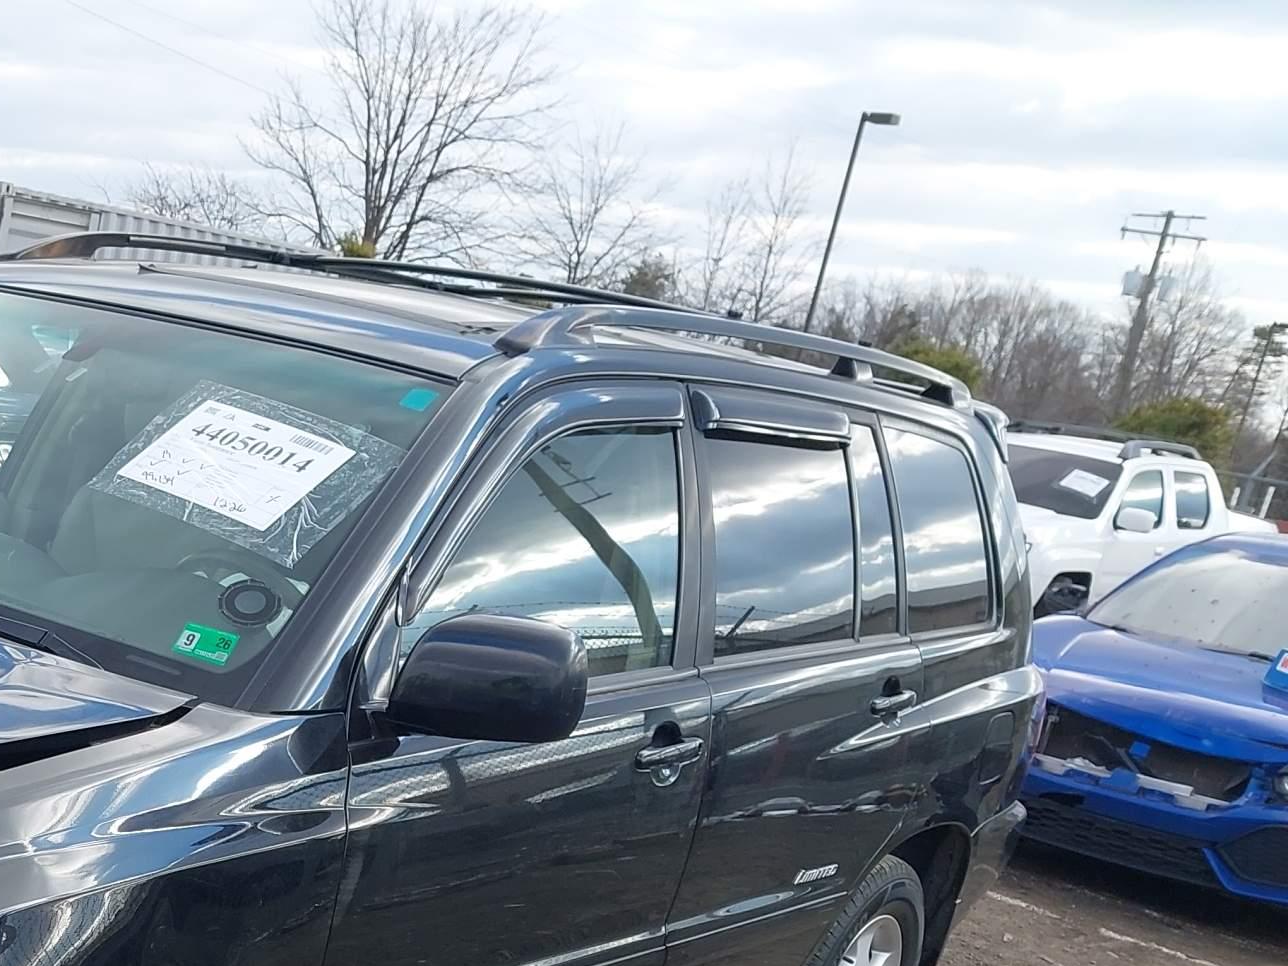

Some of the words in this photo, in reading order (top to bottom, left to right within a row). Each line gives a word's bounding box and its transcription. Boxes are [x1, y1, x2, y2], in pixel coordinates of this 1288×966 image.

[191, 422, 315, 473] 44050014
[184, 633, 196, 647] 9
[216, 637, 233, 650] 26
[793, 863, 839, 885] LIMITED
